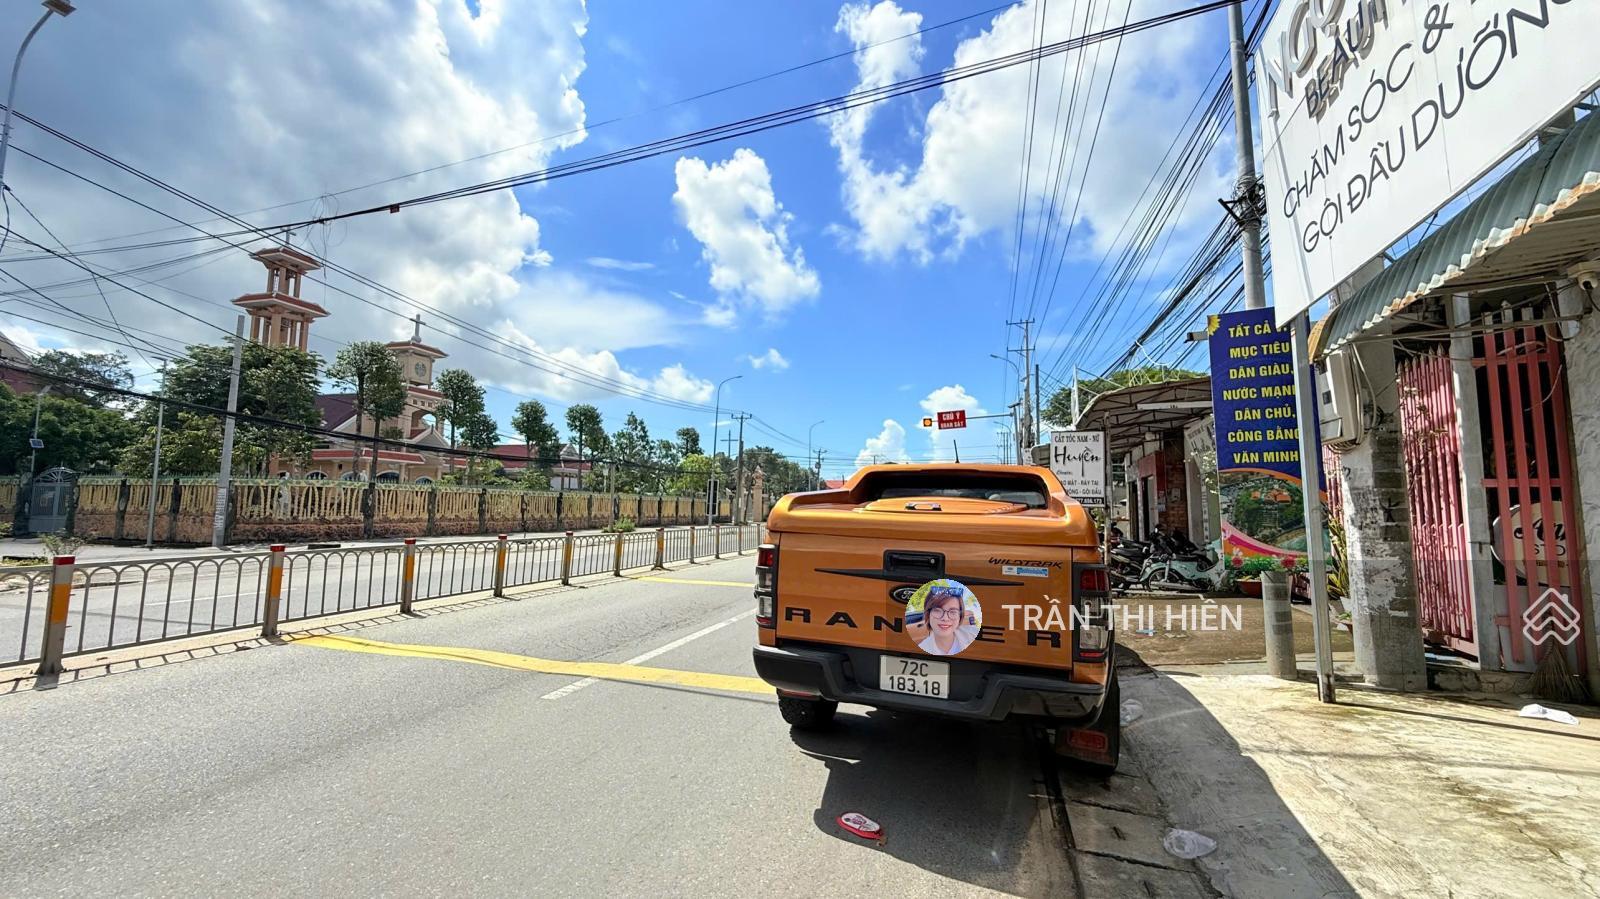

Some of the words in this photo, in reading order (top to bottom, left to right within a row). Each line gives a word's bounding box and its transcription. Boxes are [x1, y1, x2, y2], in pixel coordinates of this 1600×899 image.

[1283, 124, 1347, 218] CHĂM
[1348, 43, 1414, 143] SÓC
[1422, 3, 1454, 54] &
[1303, 193, 1344, 253] GỘI
[1346, 125, 1407, 215] ĐẦU
[1412, 0, 1572, 151] DƯỠN
[1228, 322, 1250, 338] TẤT
[1254, 320, 1271, 335] CẢ
[1229, 345, 1258, 359] MỤC
[1261, 341, 1290, 355] TIÊU
[1229, 365, 1256, 379] DÂN
[1223, 386, 1257, 400] NƯỚC
[1235, 407, 1261, 421] DÂN
[1265, 403, 1296, 419] CHỦ,
[1054, 432, 1065, 442] CẮT
[1066, 434, 1076, 442] TÓC
[1228, 429, 1262, 442] CÔNG
[1054, 445, 1101, 477] Huyền
[1233, 450, 1259, 464] VĂN
[1263, 450, 1299, 463] MINH
[988, 557, 1063, 569] WILDTRAK
[785, 606, 1061, 649] RANER
[900, 660, 929, 677] 72C
[889, 675, 940, 696] 183.18
